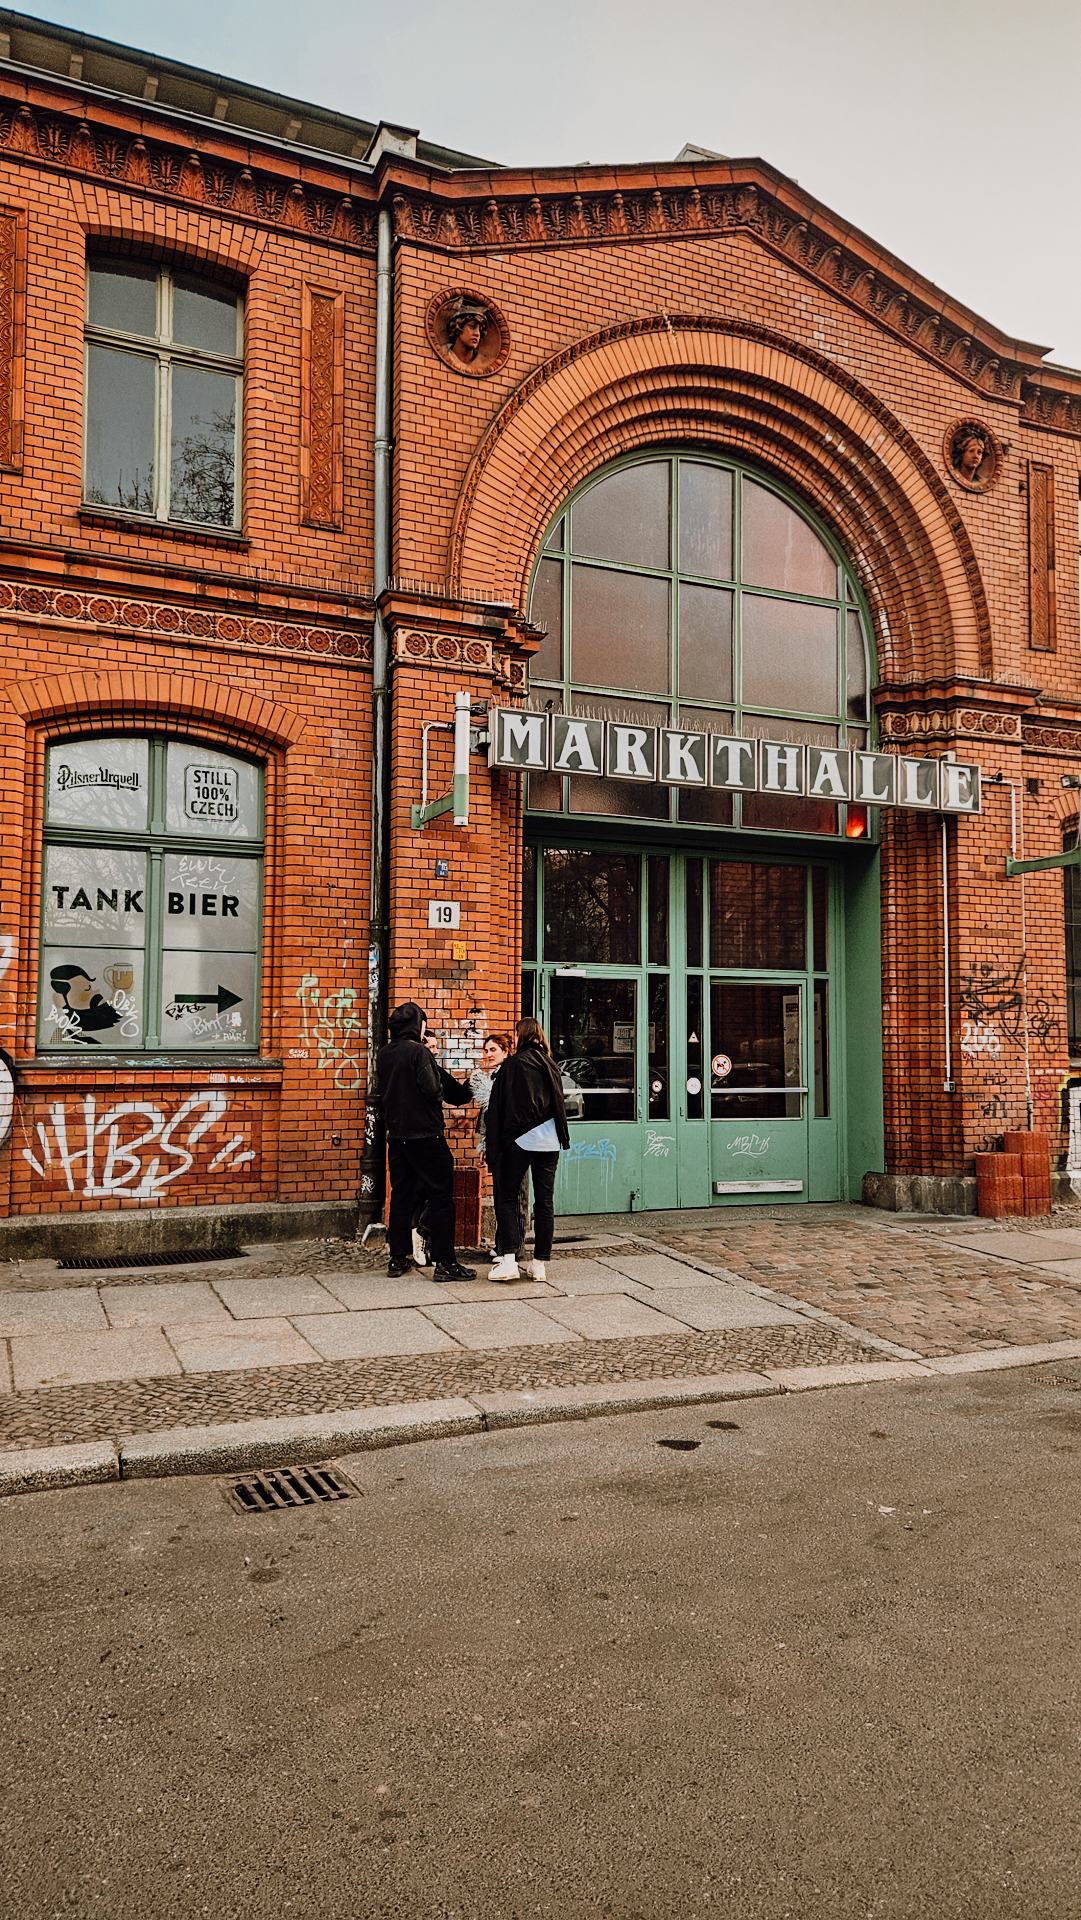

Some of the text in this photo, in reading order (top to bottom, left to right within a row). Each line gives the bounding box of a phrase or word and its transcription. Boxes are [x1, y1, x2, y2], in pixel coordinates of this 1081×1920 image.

[499, 714, 974, 810] MARKTHALLE
[57, 764, 142, 791] Pilsner Urquell
[193, 770, 232, 786] STILL
[194, 786, 230, 802] 100%
[190, 800, 234, 817] CZECH
[52, 885, 240, 918] TANK BIER
[436, 906, 452, 923] 19
